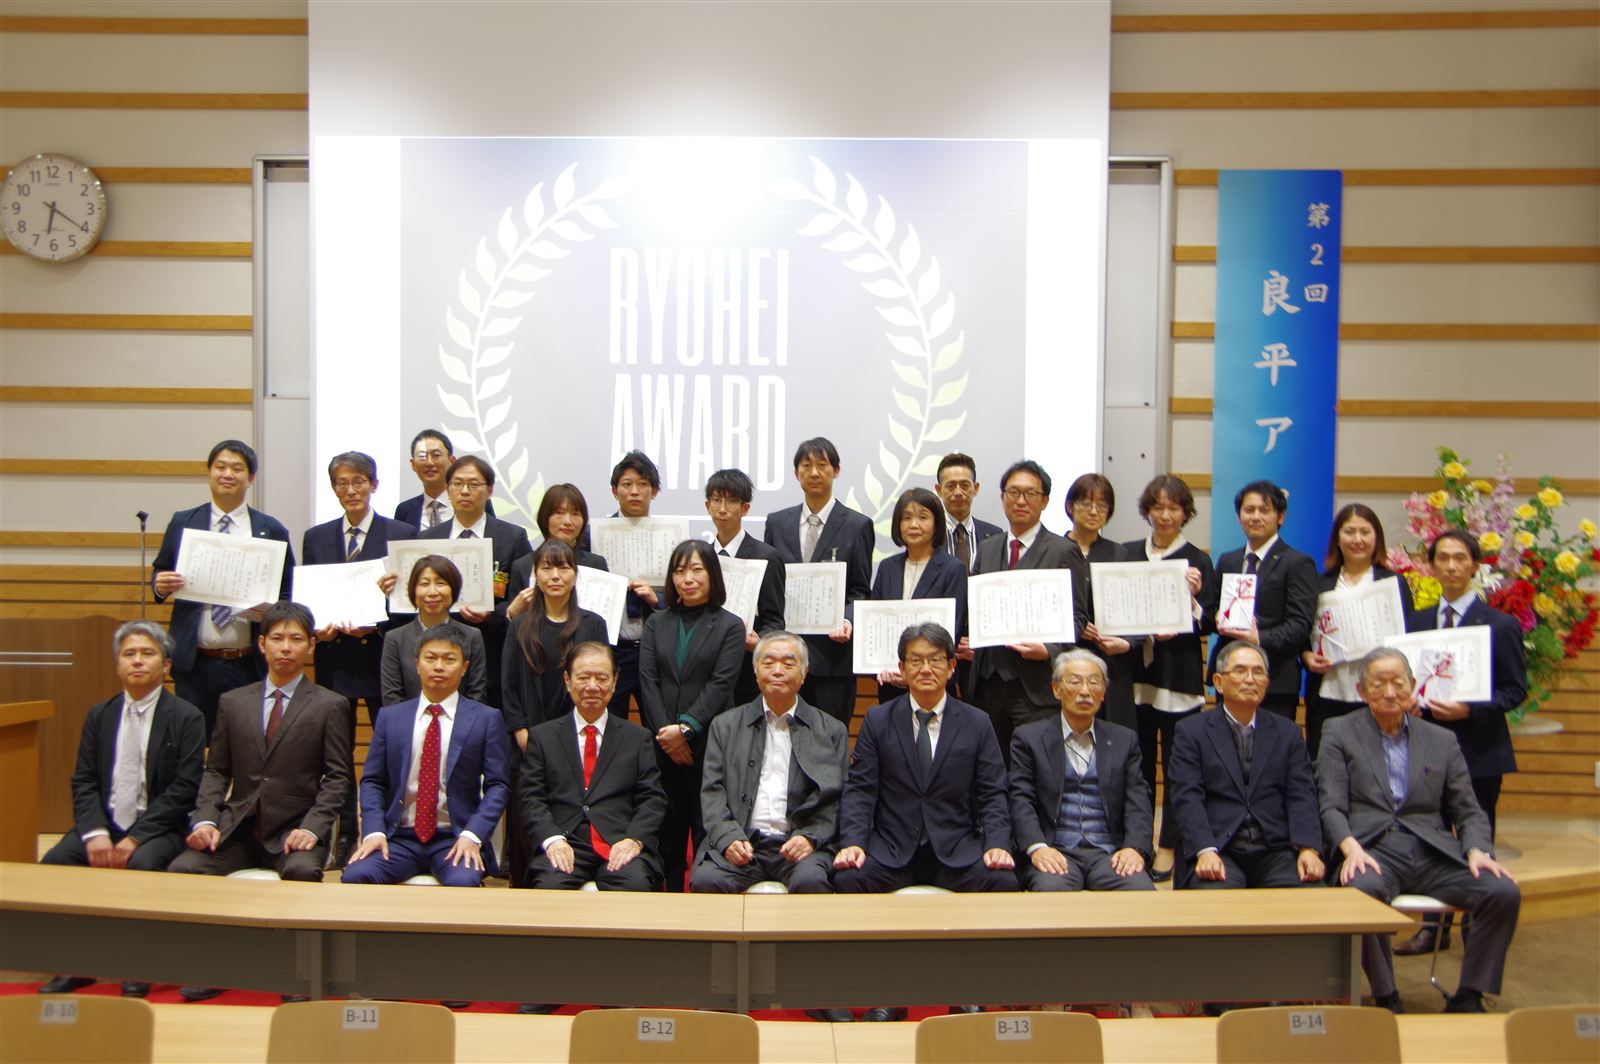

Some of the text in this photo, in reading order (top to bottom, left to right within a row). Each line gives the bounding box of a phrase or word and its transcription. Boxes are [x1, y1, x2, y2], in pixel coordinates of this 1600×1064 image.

[30, 170, 41, 183] 11
[46, 166, 60, 178] 12
[68, 170, 73, 183] 1
[17, 184, 31, 197] 10
[81, 184, 89, 197] 2
[12, 202, 21, 215] 9
[86, 203, 95, 215] 3
[18, 220, 26, 233] 8
[81, 221, 89, 233] 4
[32, 234, 40, 246] 7
[50, 239, 58, 251] 6
[68, 235, 76, 247] 5
[1303, 202, 1330, 304] 第2回
[609, 247, 790, 367] RYOHEI
[1254, 270, 1300, 500] 良平ア
[610, 373, 787, 491] AWARD
[43, 1003, 76, 1016] B-10
[346, 1009, 377, 1023] B-11
[641, 1020, 673, 1035] B-12
[998, 1020, 1030, 1034] B-13
[1292, 1014, 1323, 1029] B-14
[1578, 1016, 1600, 1032] B-1
